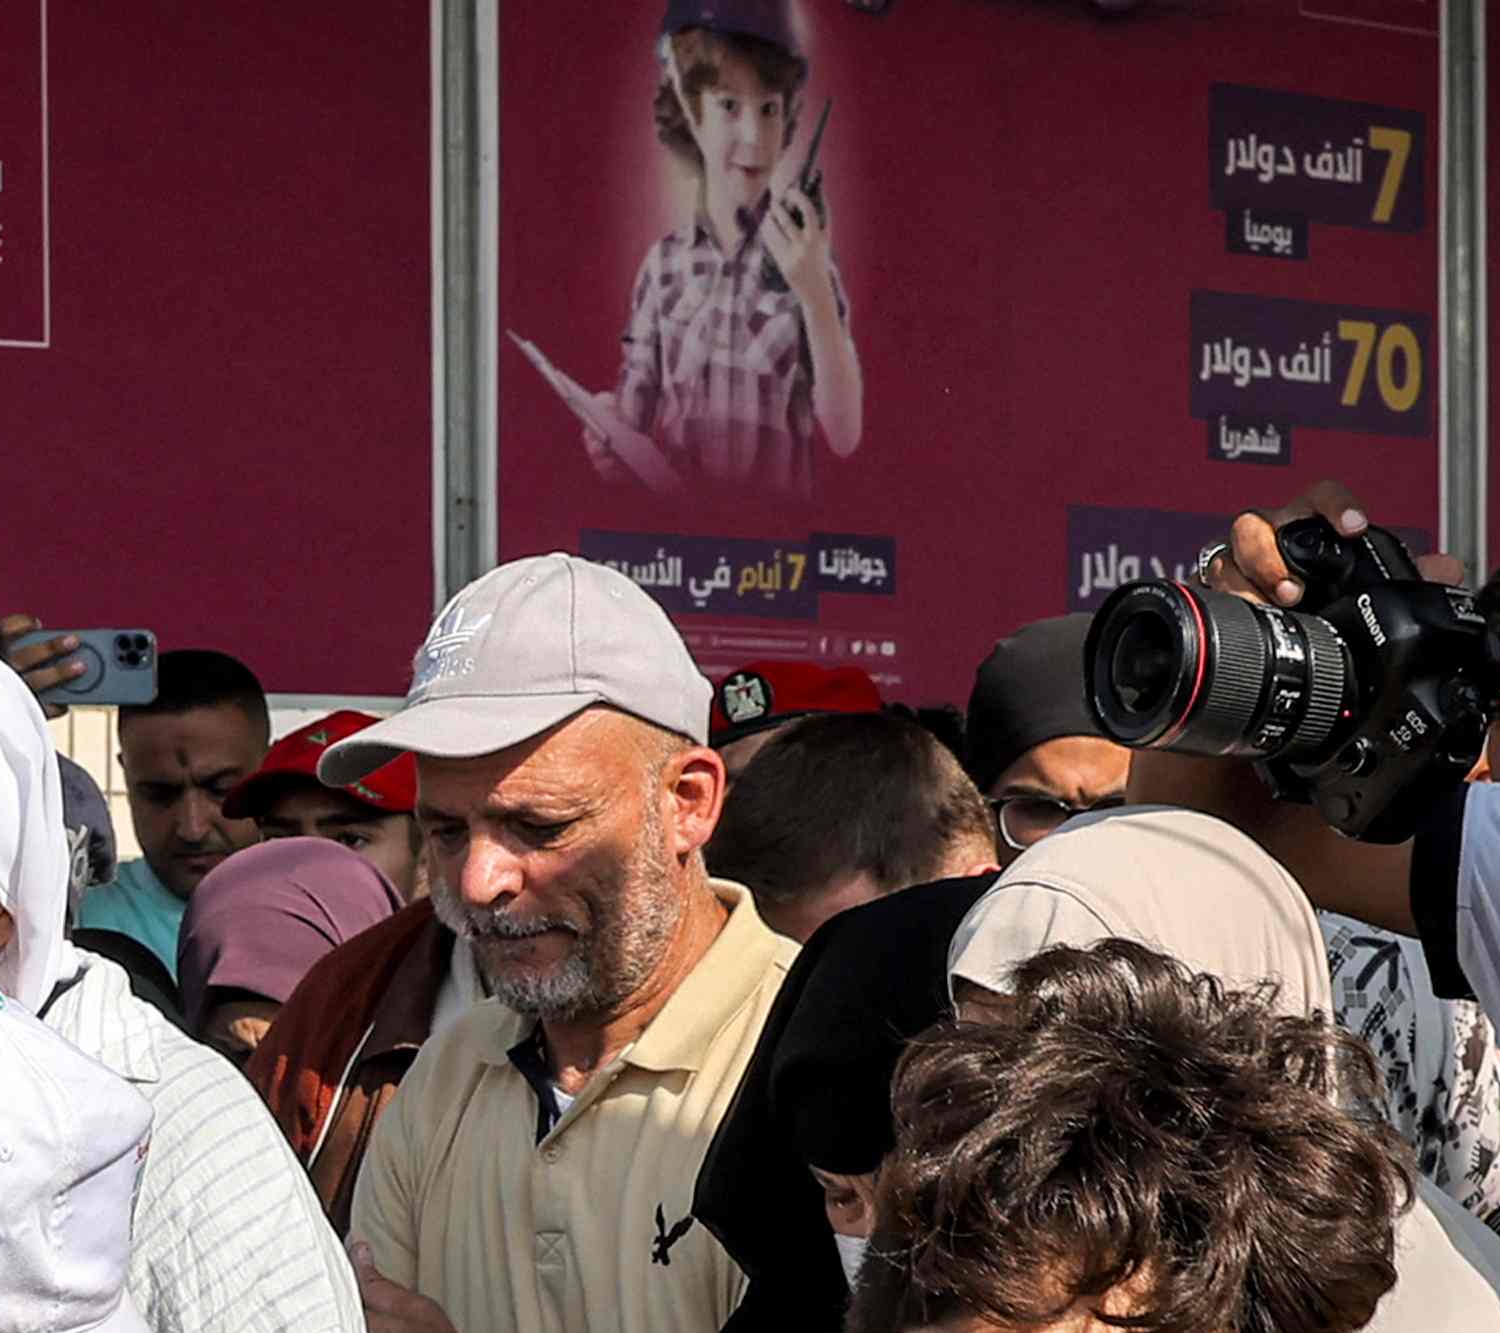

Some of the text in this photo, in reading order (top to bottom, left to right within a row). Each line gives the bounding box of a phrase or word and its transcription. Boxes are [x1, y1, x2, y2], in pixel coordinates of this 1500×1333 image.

[1224, 133, 1297, 184] دولار
[1368, 125, 1411, 223] 7
[1199, 320, 1422, 413] 70 ألف دولار
[688, 556, 732, 608] في
[786, 553, 808, 591] 7
[1357, 593, 1387, 647] Canon
[1405, 709, 1429, 735] EOS
